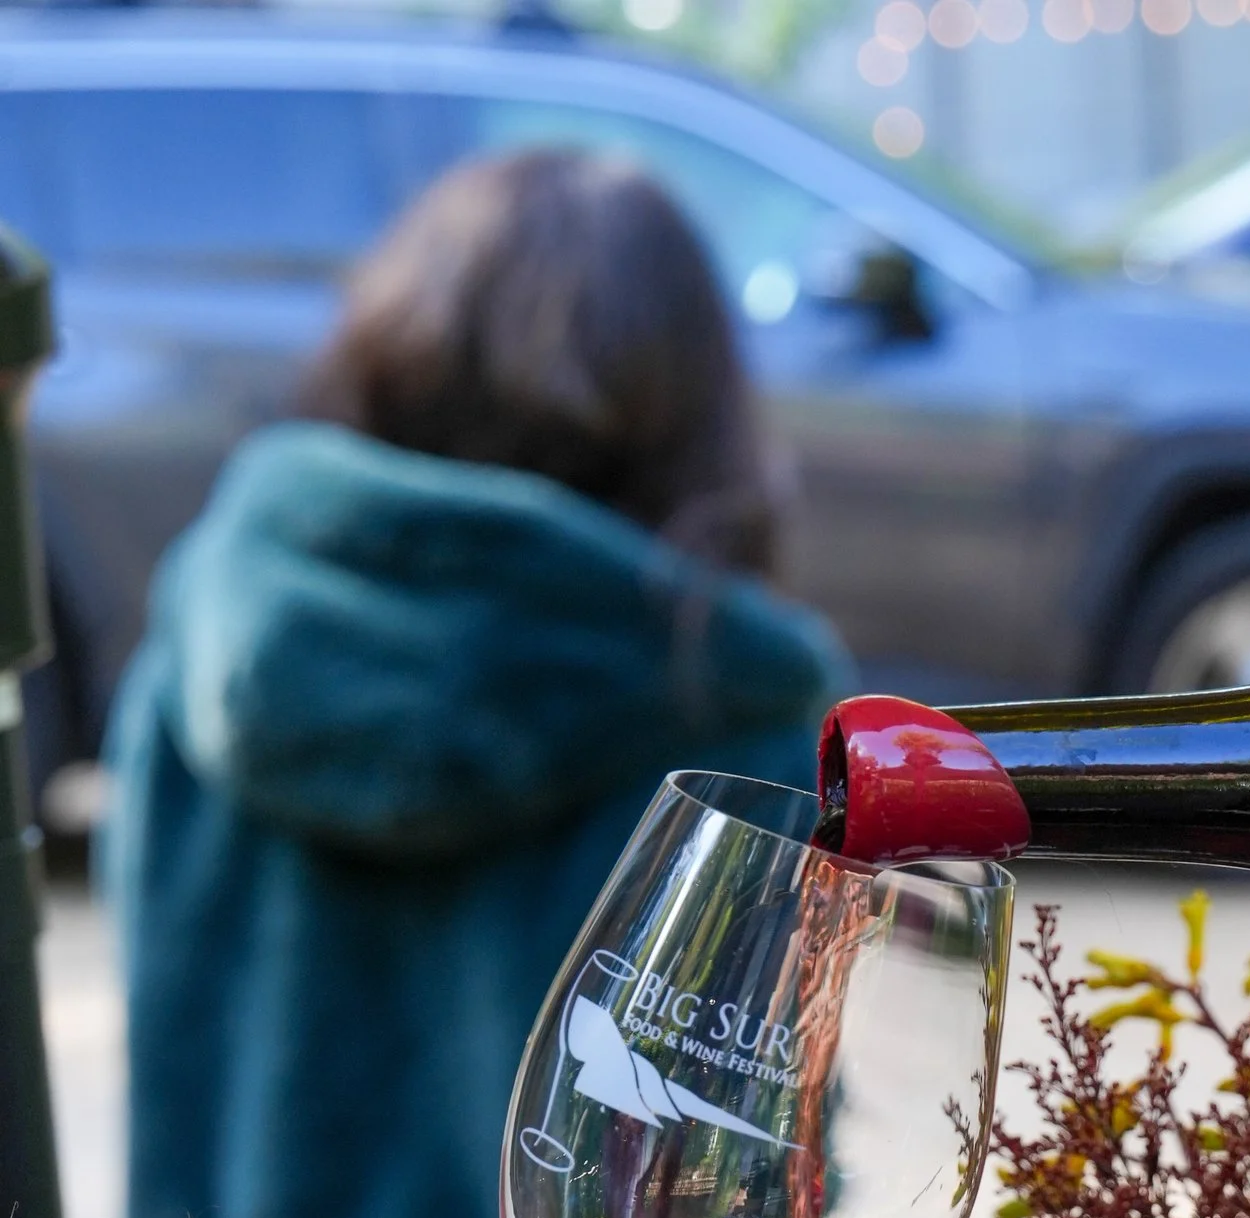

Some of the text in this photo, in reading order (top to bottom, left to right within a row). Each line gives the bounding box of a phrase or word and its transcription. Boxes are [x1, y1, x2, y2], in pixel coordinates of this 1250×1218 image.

[622, 1013, 801, 1088] FOOD & WINE FESTIVAL
[635, 972, 793, 1062] BIG SUR
